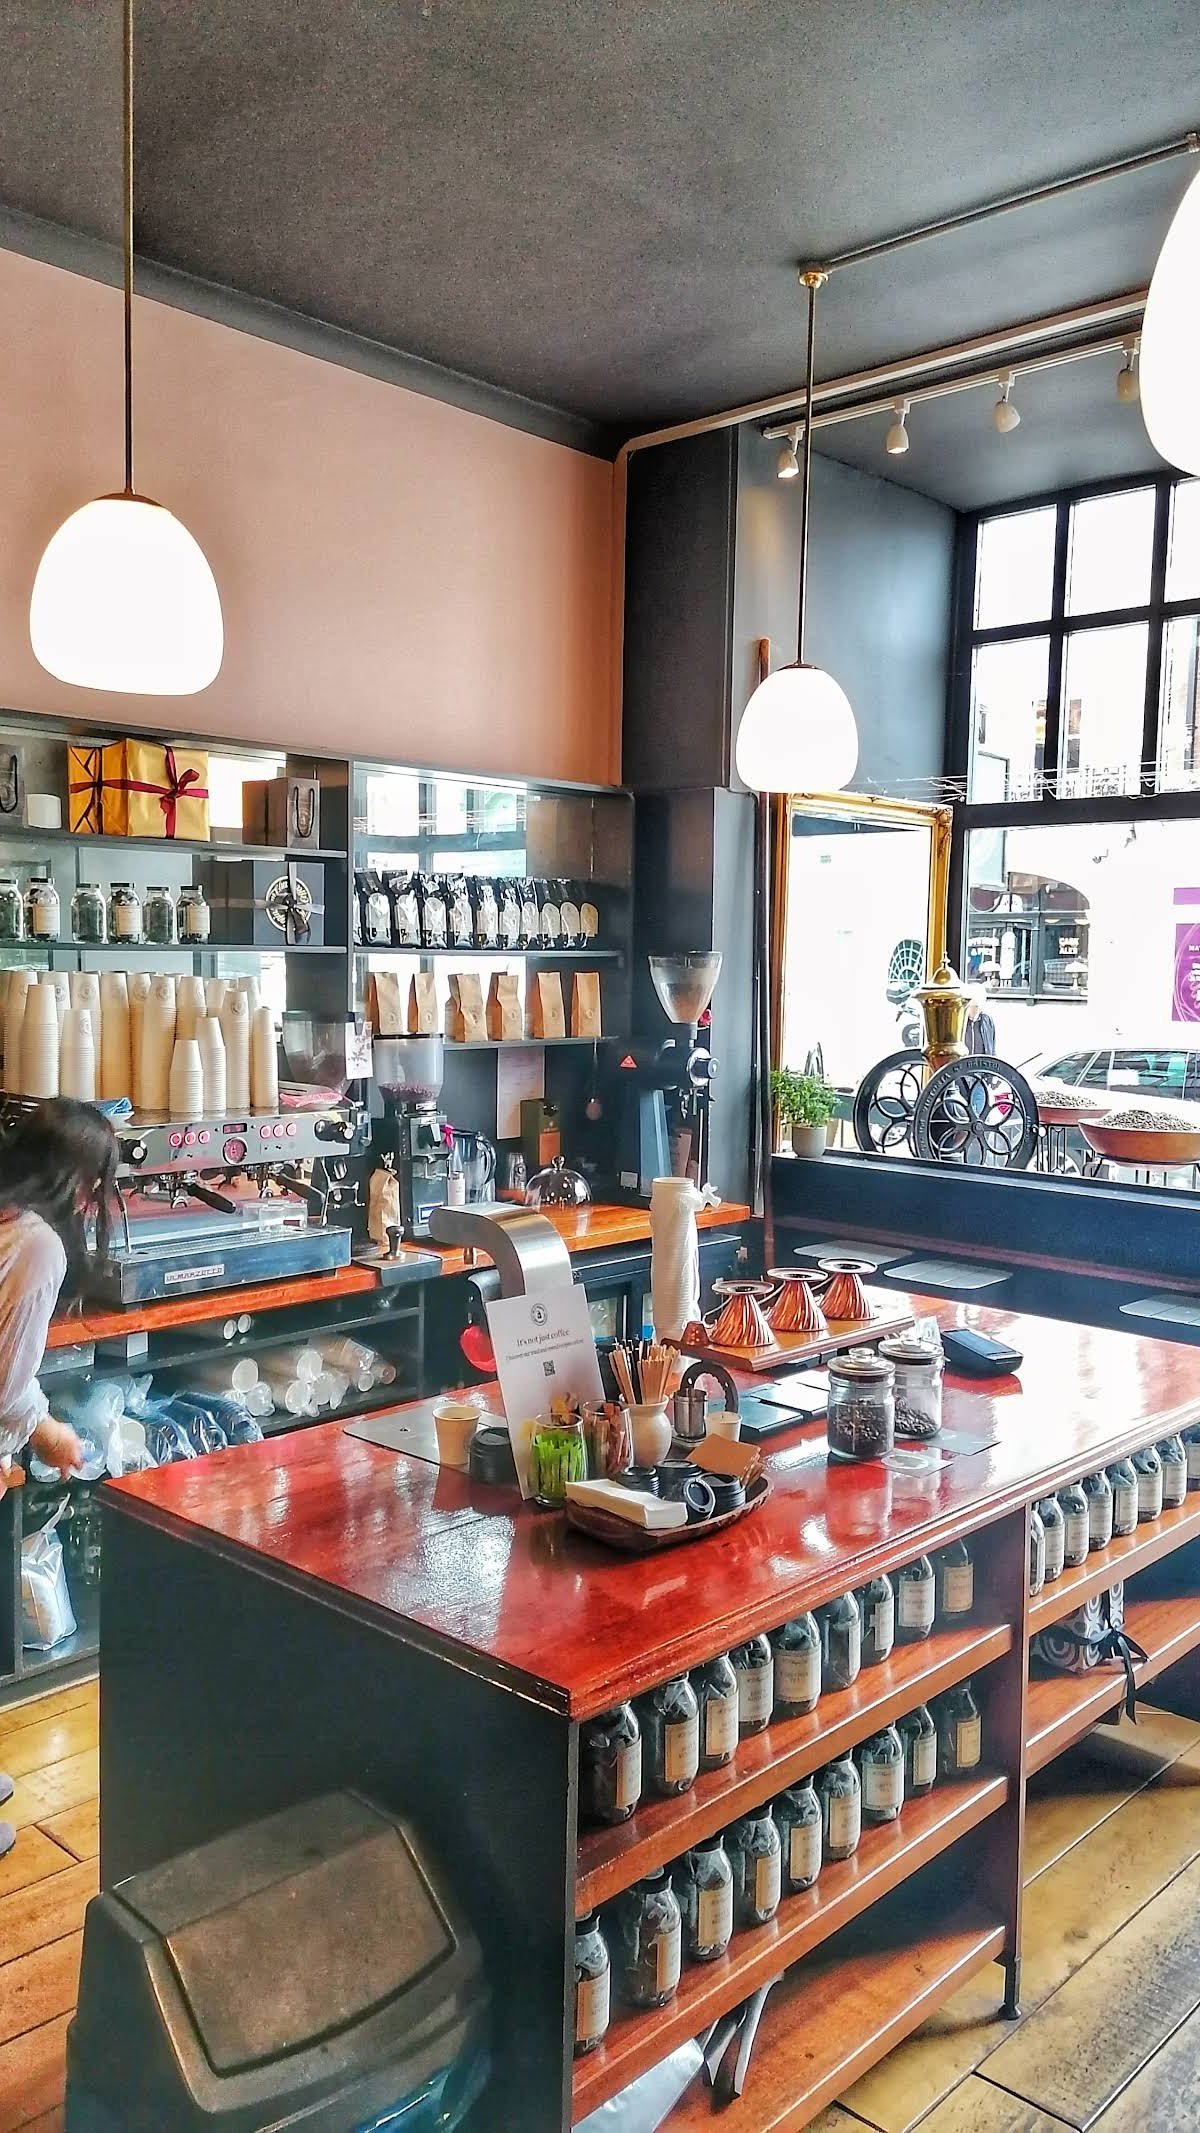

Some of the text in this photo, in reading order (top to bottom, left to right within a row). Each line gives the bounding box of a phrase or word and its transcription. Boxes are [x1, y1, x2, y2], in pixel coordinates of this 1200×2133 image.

[517, 1328, 570, 1347] It's not just coffee
